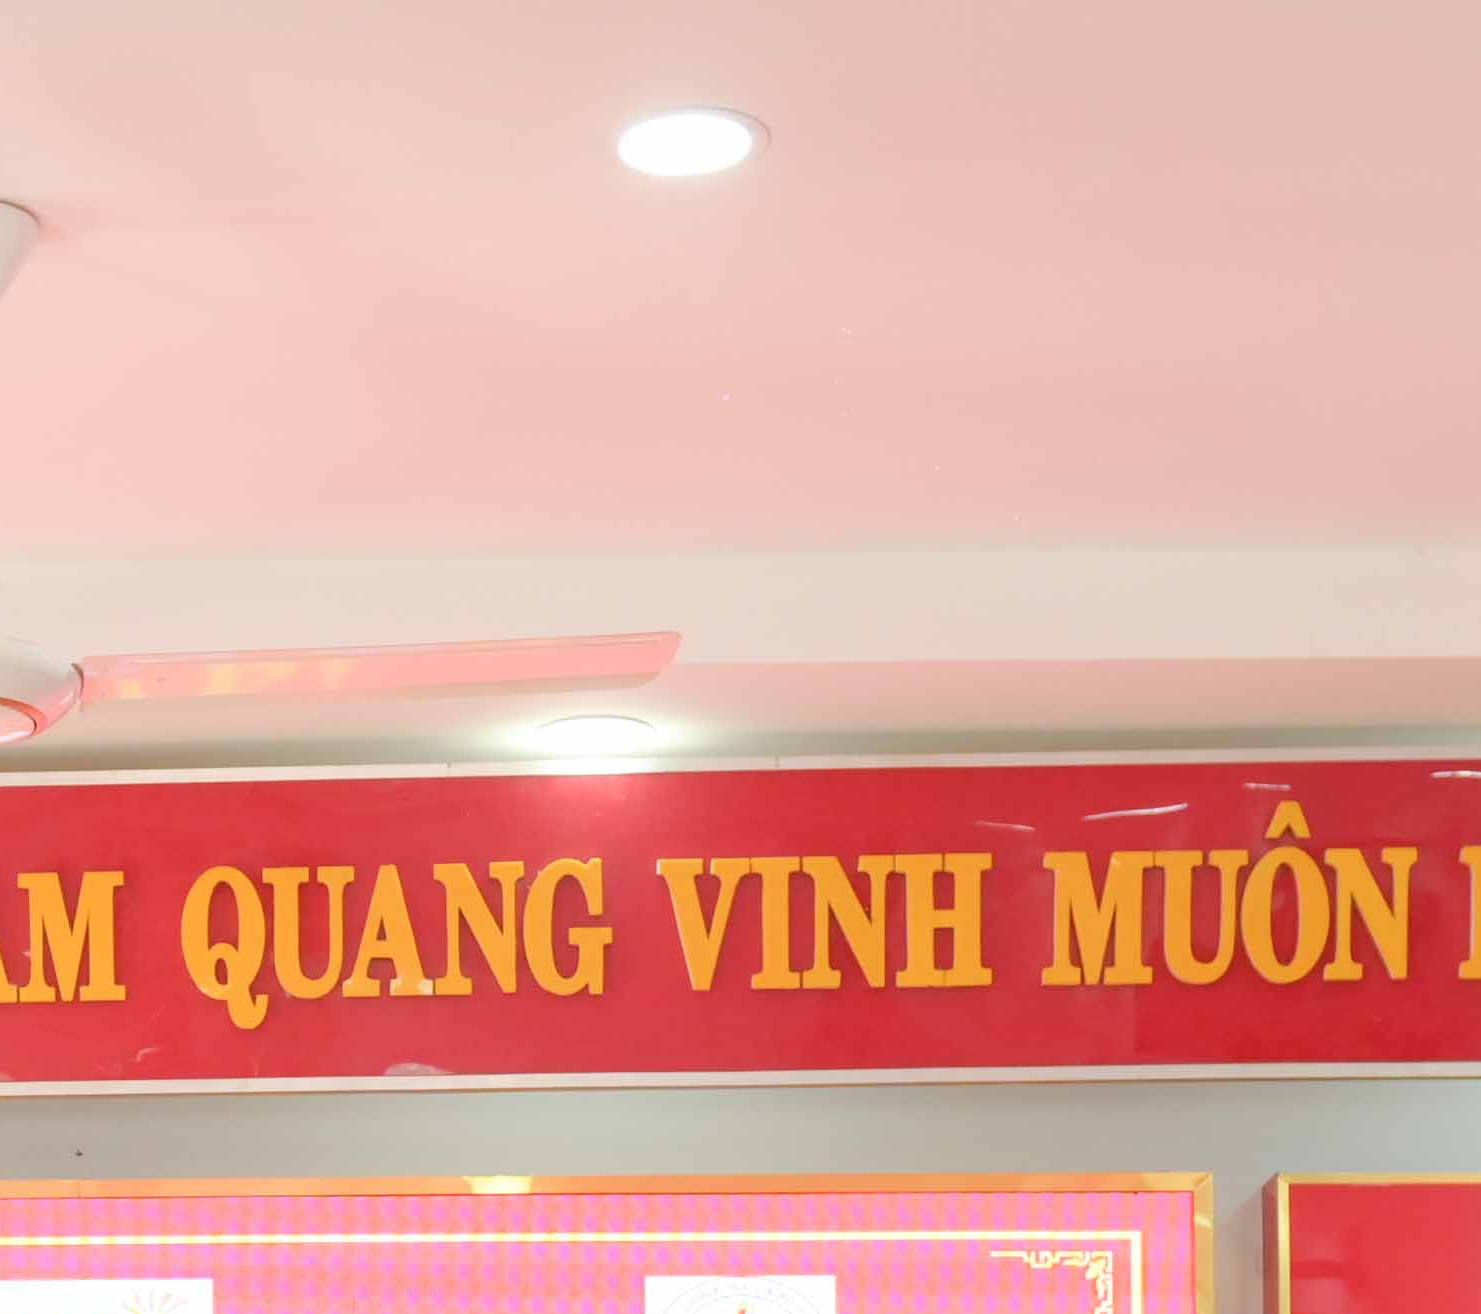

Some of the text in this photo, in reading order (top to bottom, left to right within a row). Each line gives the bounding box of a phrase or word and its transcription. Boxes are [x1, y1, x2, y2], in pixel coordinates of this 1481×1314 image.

[179, 859, 613, 1030] QUANG
[657, 853, 992, 990] VINH
[1041, 801, 1415, 988] MUÔN
